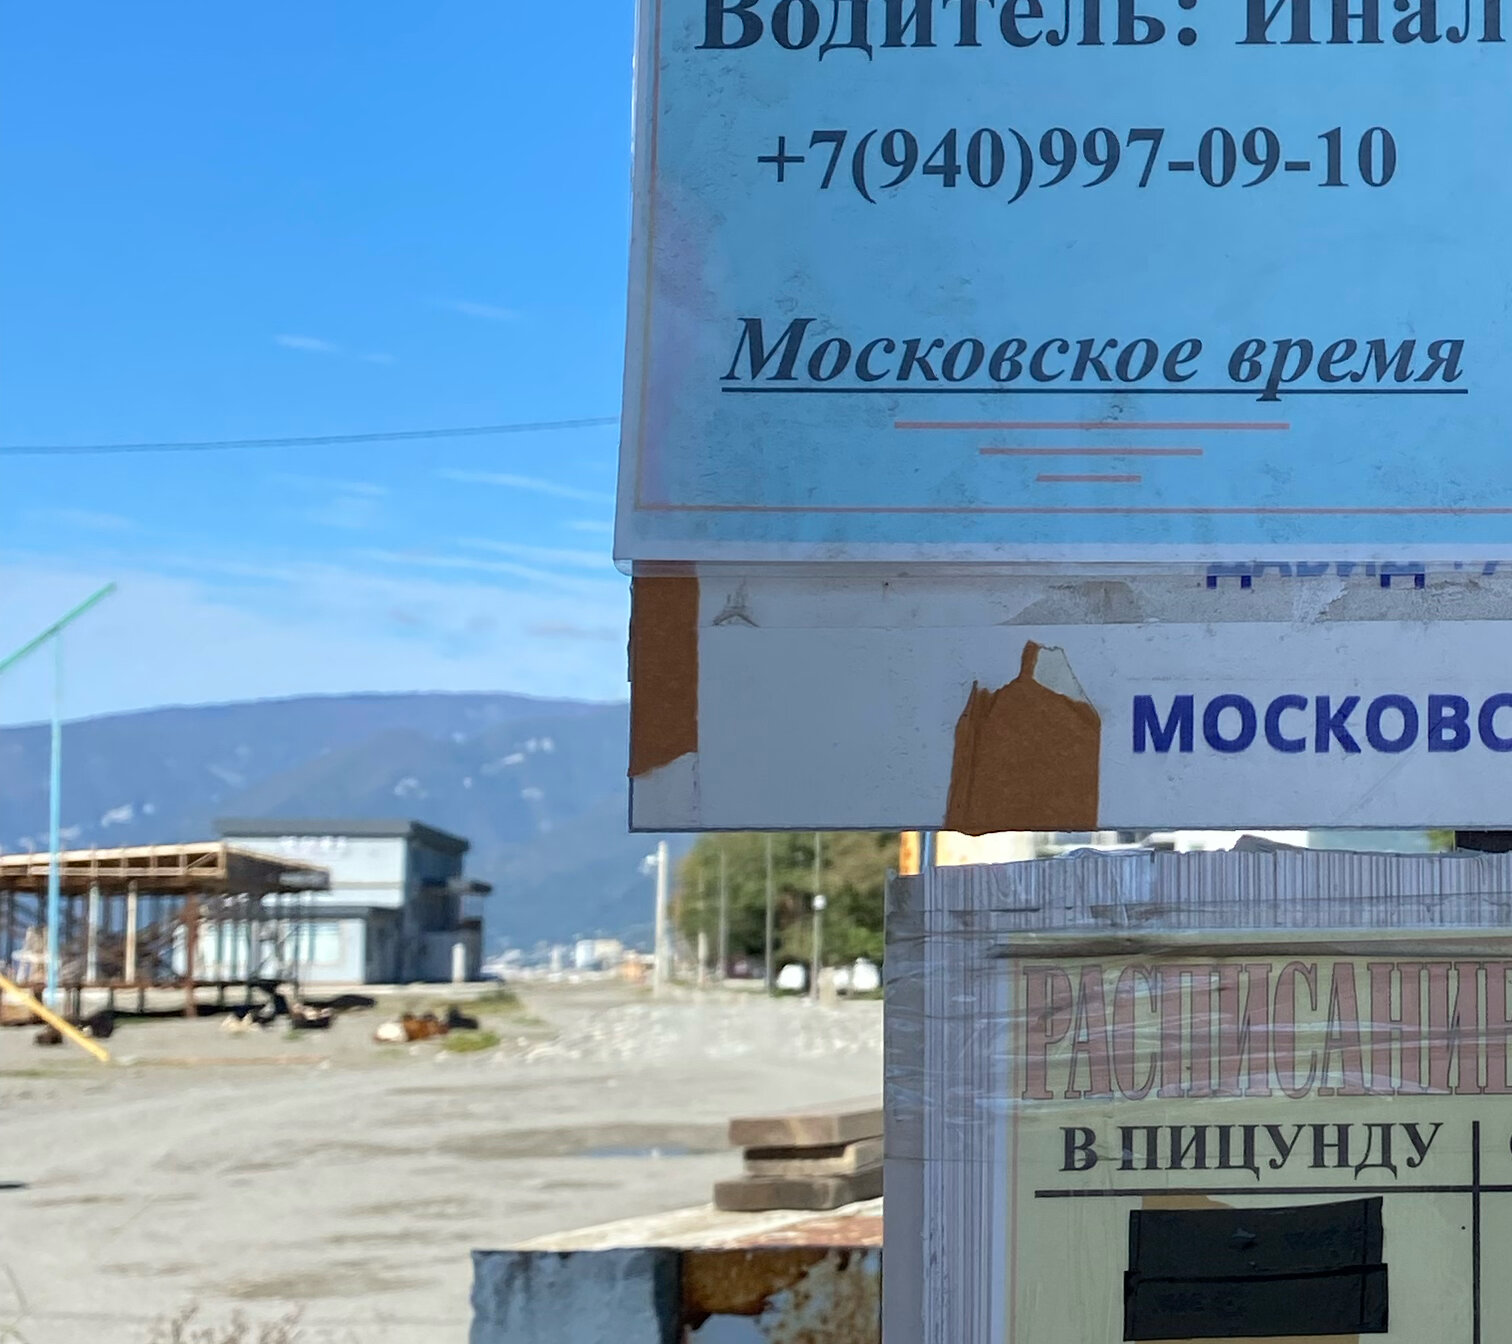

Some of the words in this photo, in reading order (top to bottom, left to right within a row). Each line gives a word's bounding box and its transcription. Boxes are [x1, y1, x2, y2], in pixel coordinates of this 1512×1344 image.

[757, 127, 1396, 204] +7(940)997-09-10
[722, 317, 1202, 385] Московское
[1228, 336, 1466, 402] время
[1059, 1127, 1099, 1171] В
[1117, 1123, 1443, 1181] ПИЦУНДУ
